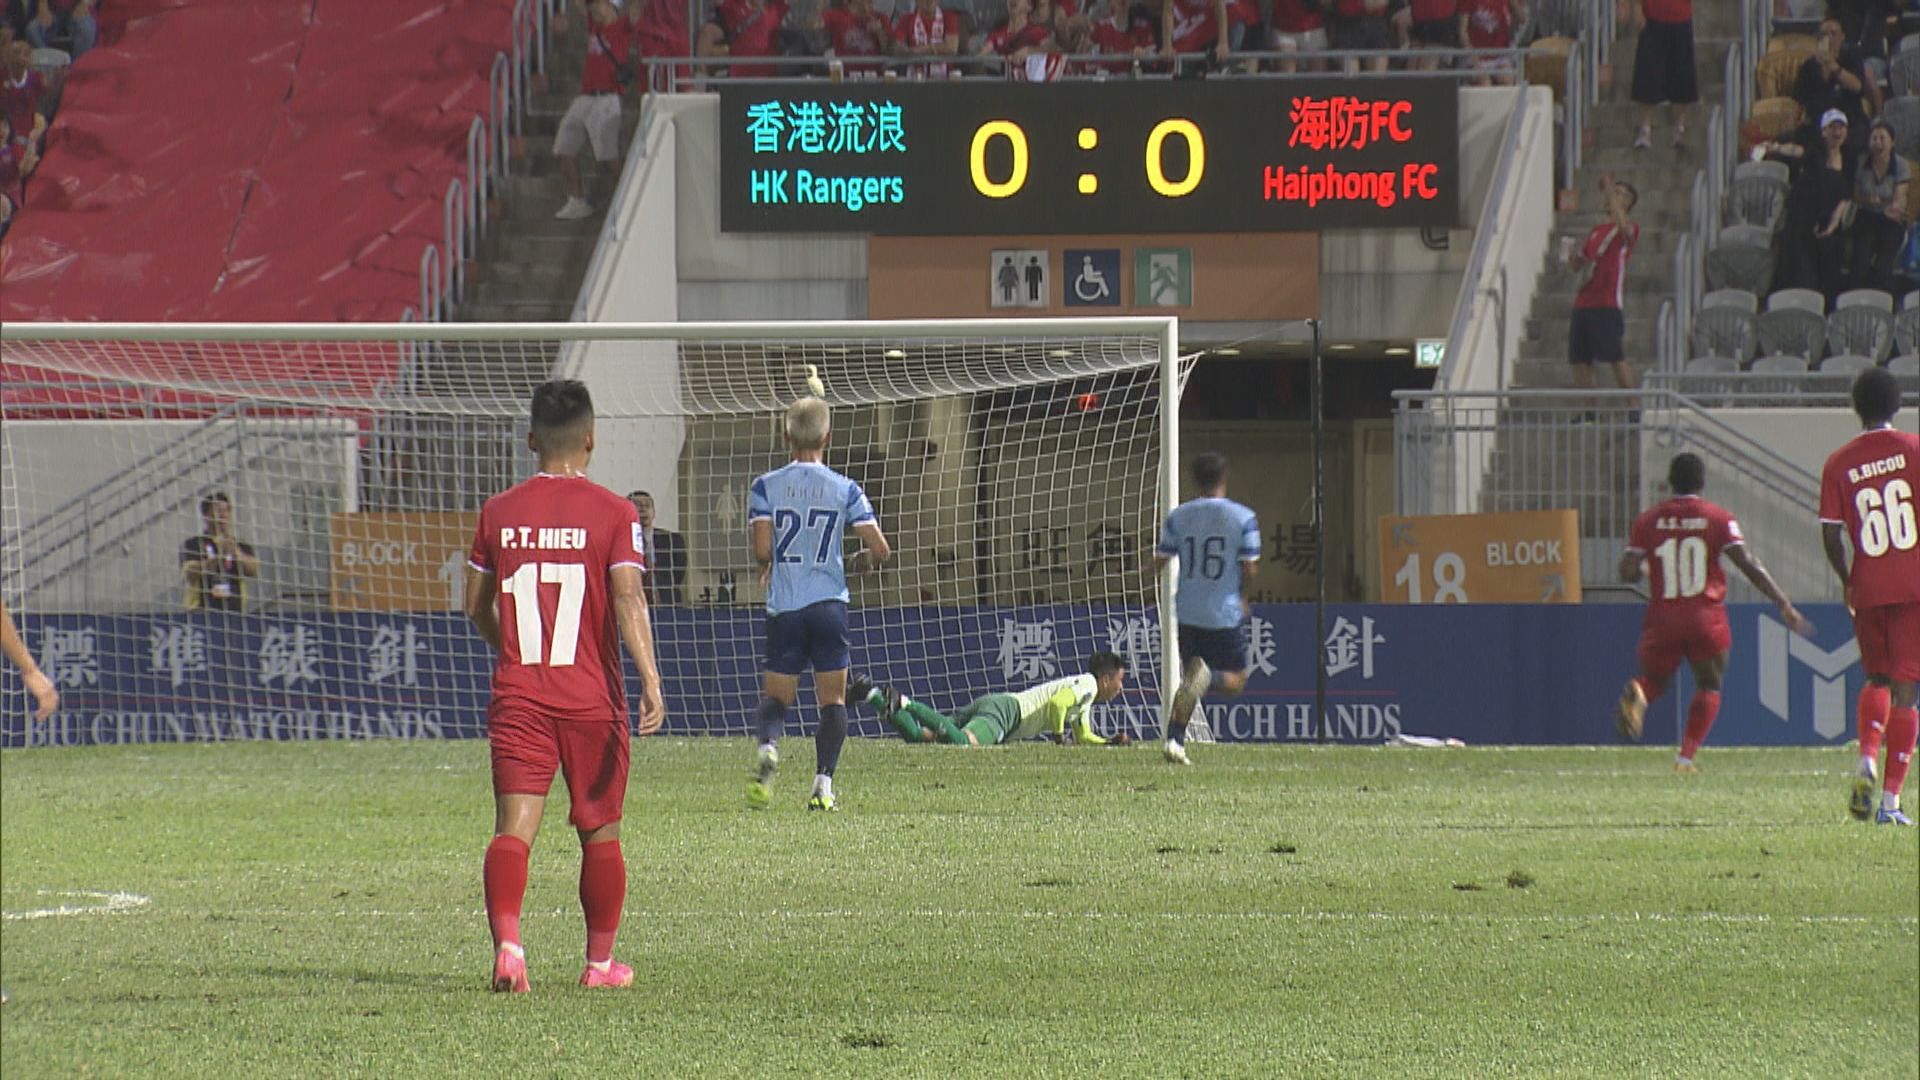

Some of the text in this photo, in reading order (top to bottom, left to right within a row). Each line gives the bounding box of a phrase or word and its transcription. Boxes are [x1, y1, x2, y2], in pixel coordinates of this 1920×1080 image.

[746, 100, 907, 153] 香港流浪
[1288, 96, 1413, 150] 海防FC
[970, 120, 1029, 197] 0
[1146, 118, 1205, 197] 0
[750, 169, 904, 211] HK Rangers
[1263, 163, 1438, 208] Haiphong FC
[1420, 343, 1444, 365] EX
[774, 507, 839, 564] 27
[1855, 479, 1918, 557] 66
[341, 541, 418, 566] BLOCK
[1183, 535, 1226, 581] 16
[1395, 551, 1469, 605] 18
[1486, 540, 1562, 567] BLOCK
[1654, 536, 1708, 599] 10
[501, 562, 586, 667] 17
[90, 711, 187, 746] CHUN
[326, 710, 444, 741] HANDS
[1285, 703, 1401, 739] HANDS
